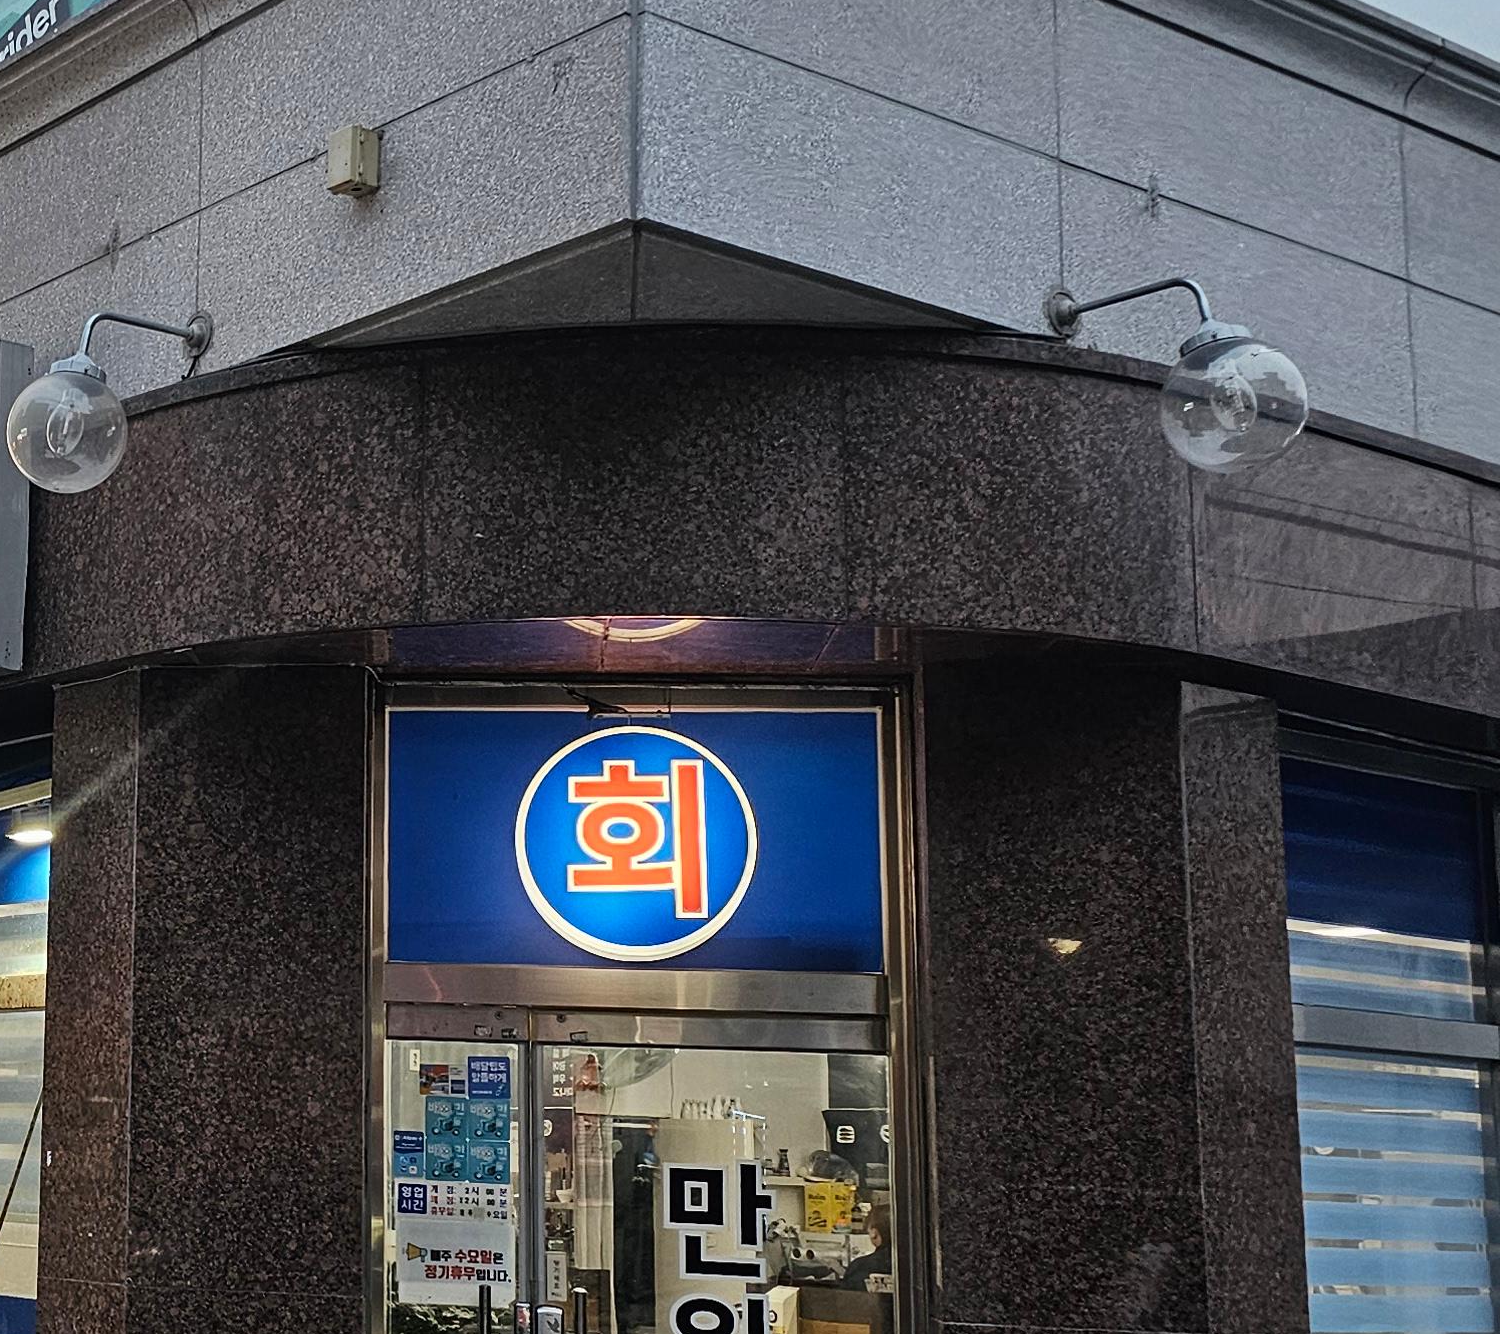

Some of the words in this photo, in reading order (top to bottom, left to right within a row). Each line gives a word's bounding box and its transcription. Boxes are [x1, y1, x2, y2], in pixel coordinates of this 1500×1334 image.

[567, 758, 709, 919] 회
[401, 1186, 424, 1198] 영업
[401, 1199, 424, 1211] 시간
[454, 1248, 504, 1265] 수요일은
[424, 1265, 512, 1283] 정기휴무입니다.
